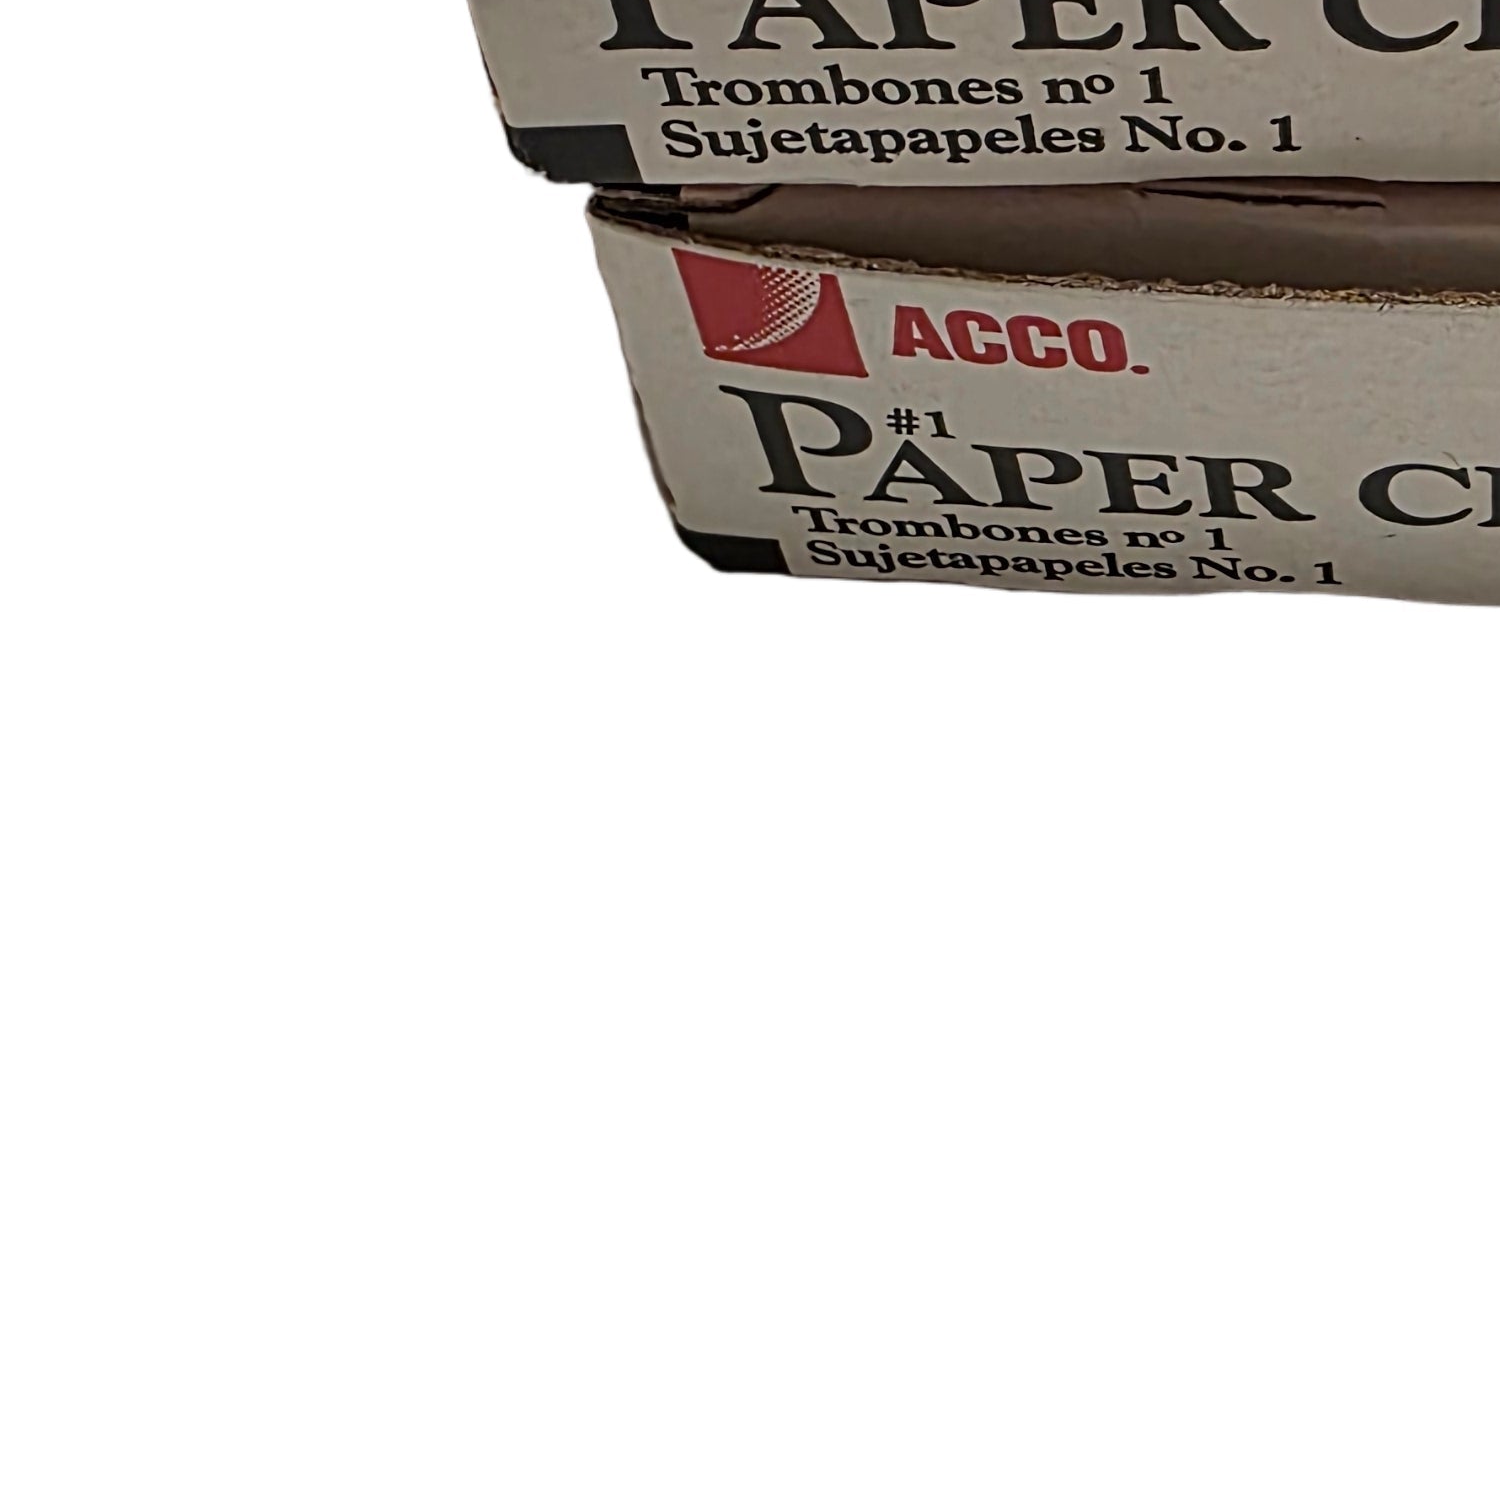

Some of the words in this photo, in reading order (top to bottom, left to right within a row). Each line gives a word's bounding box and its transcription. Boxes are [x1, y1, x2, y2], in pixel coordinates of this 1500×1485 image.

[640, 64, 1024, 108] Trombones
[1139, 67, 1175, 105] 1
[664, 114, 1106, 164] Sujetapapeles
[1124, 115, 1248, 156] No.
[1269, 115, 1302, 153] 1
[885, 407, 957, 439] #1
[717, 384, 1317, 522] PAPER
[791, 505, 1108, 549] Trombones
[1205, 527, 1235, 551] 1
[806, 540, 1177, 581] Sujetapapeles
[1191, 556, 1296, 584] No.
[1313, 561, 1343, 586] 1
